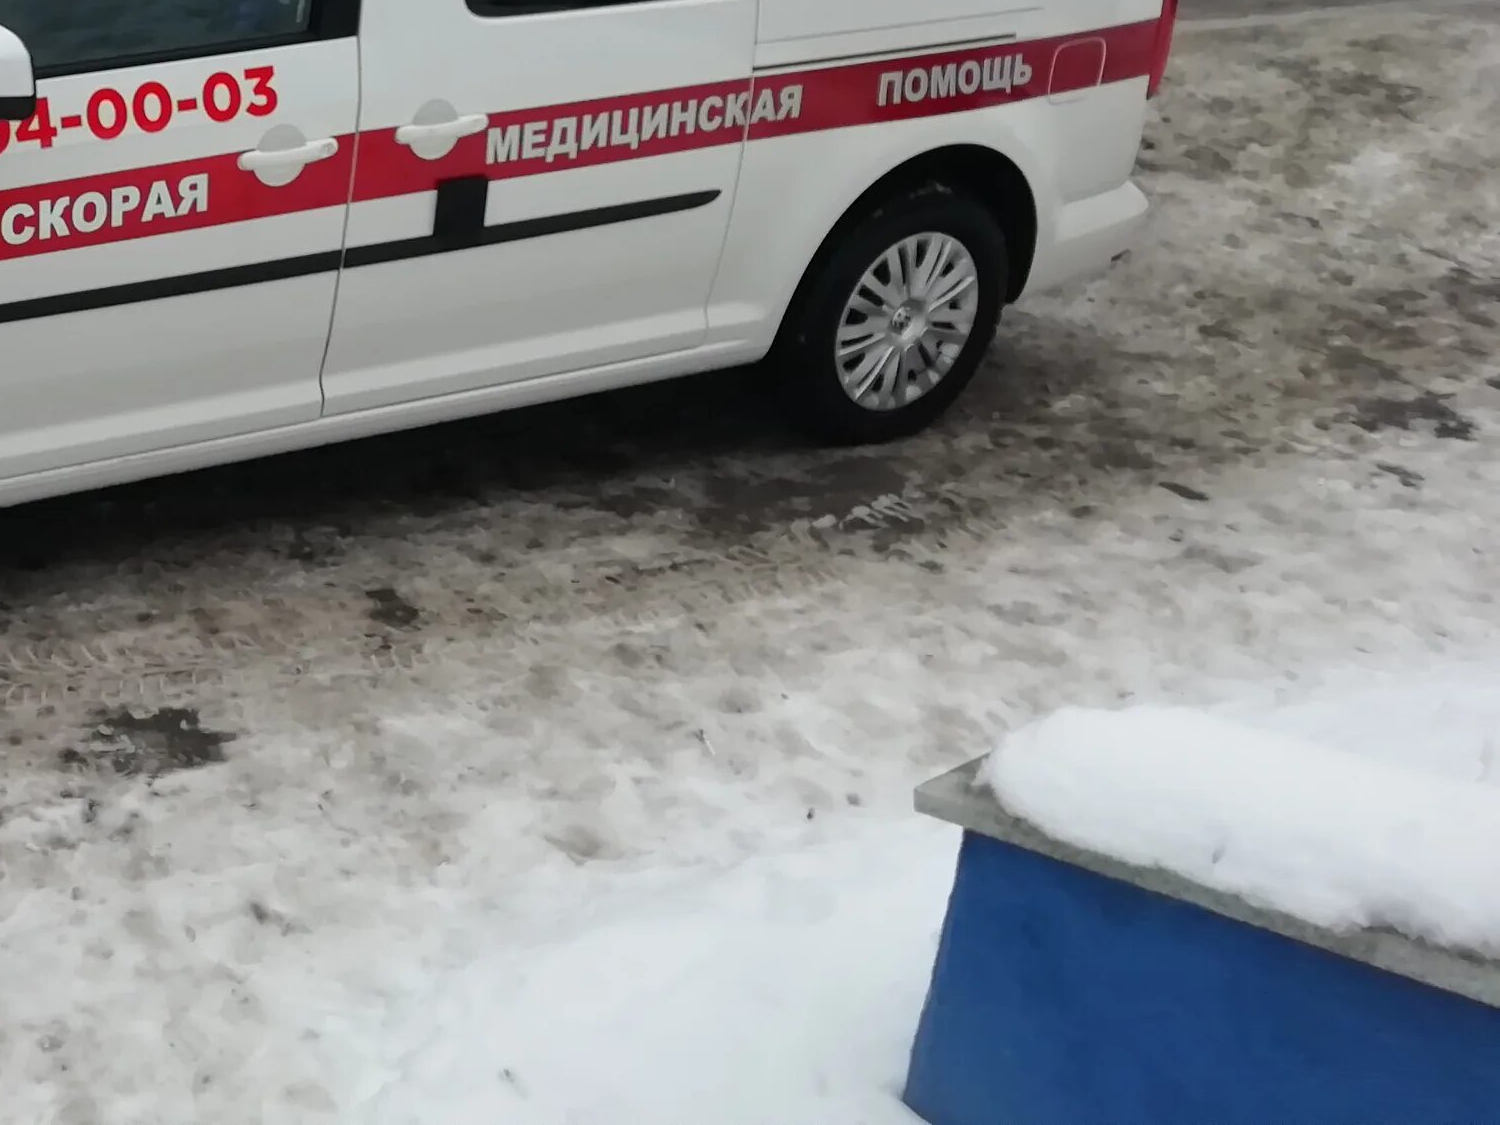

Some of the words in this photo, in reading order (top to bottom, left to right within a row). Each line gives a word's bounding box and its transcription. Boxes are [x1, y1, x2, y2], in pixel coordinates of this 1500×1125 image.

[0, 172, 210, 246] СКОРАЯ
[485, 84, 804, 165] МЕДИЦИНСКАЯ
[877, 53, 1033, 107] ПОМОЩЬ
